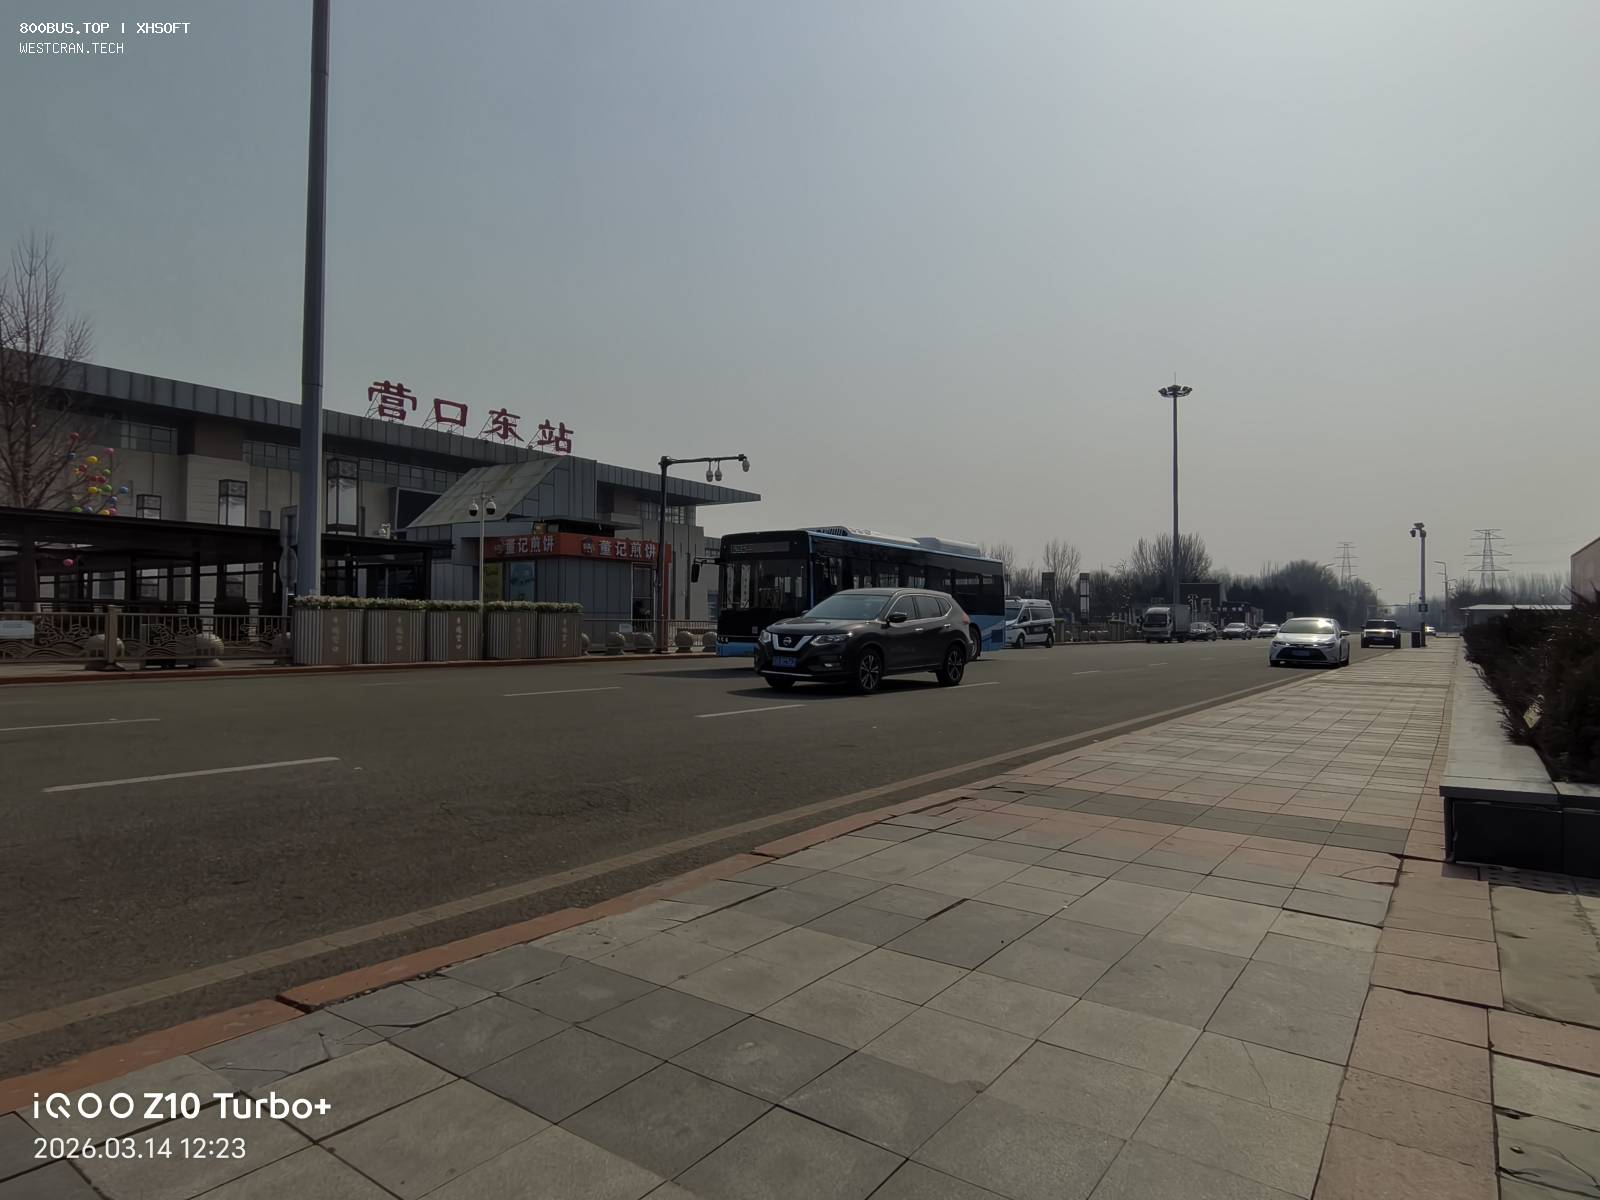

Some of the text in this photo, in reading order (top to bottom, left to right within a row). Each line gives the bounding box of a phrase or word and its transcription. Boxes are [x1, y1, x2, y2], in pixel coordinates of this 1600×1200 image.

[367, 380, 574, 454] 营口东站
[598, 540, 658, 561] 董记煎饼
